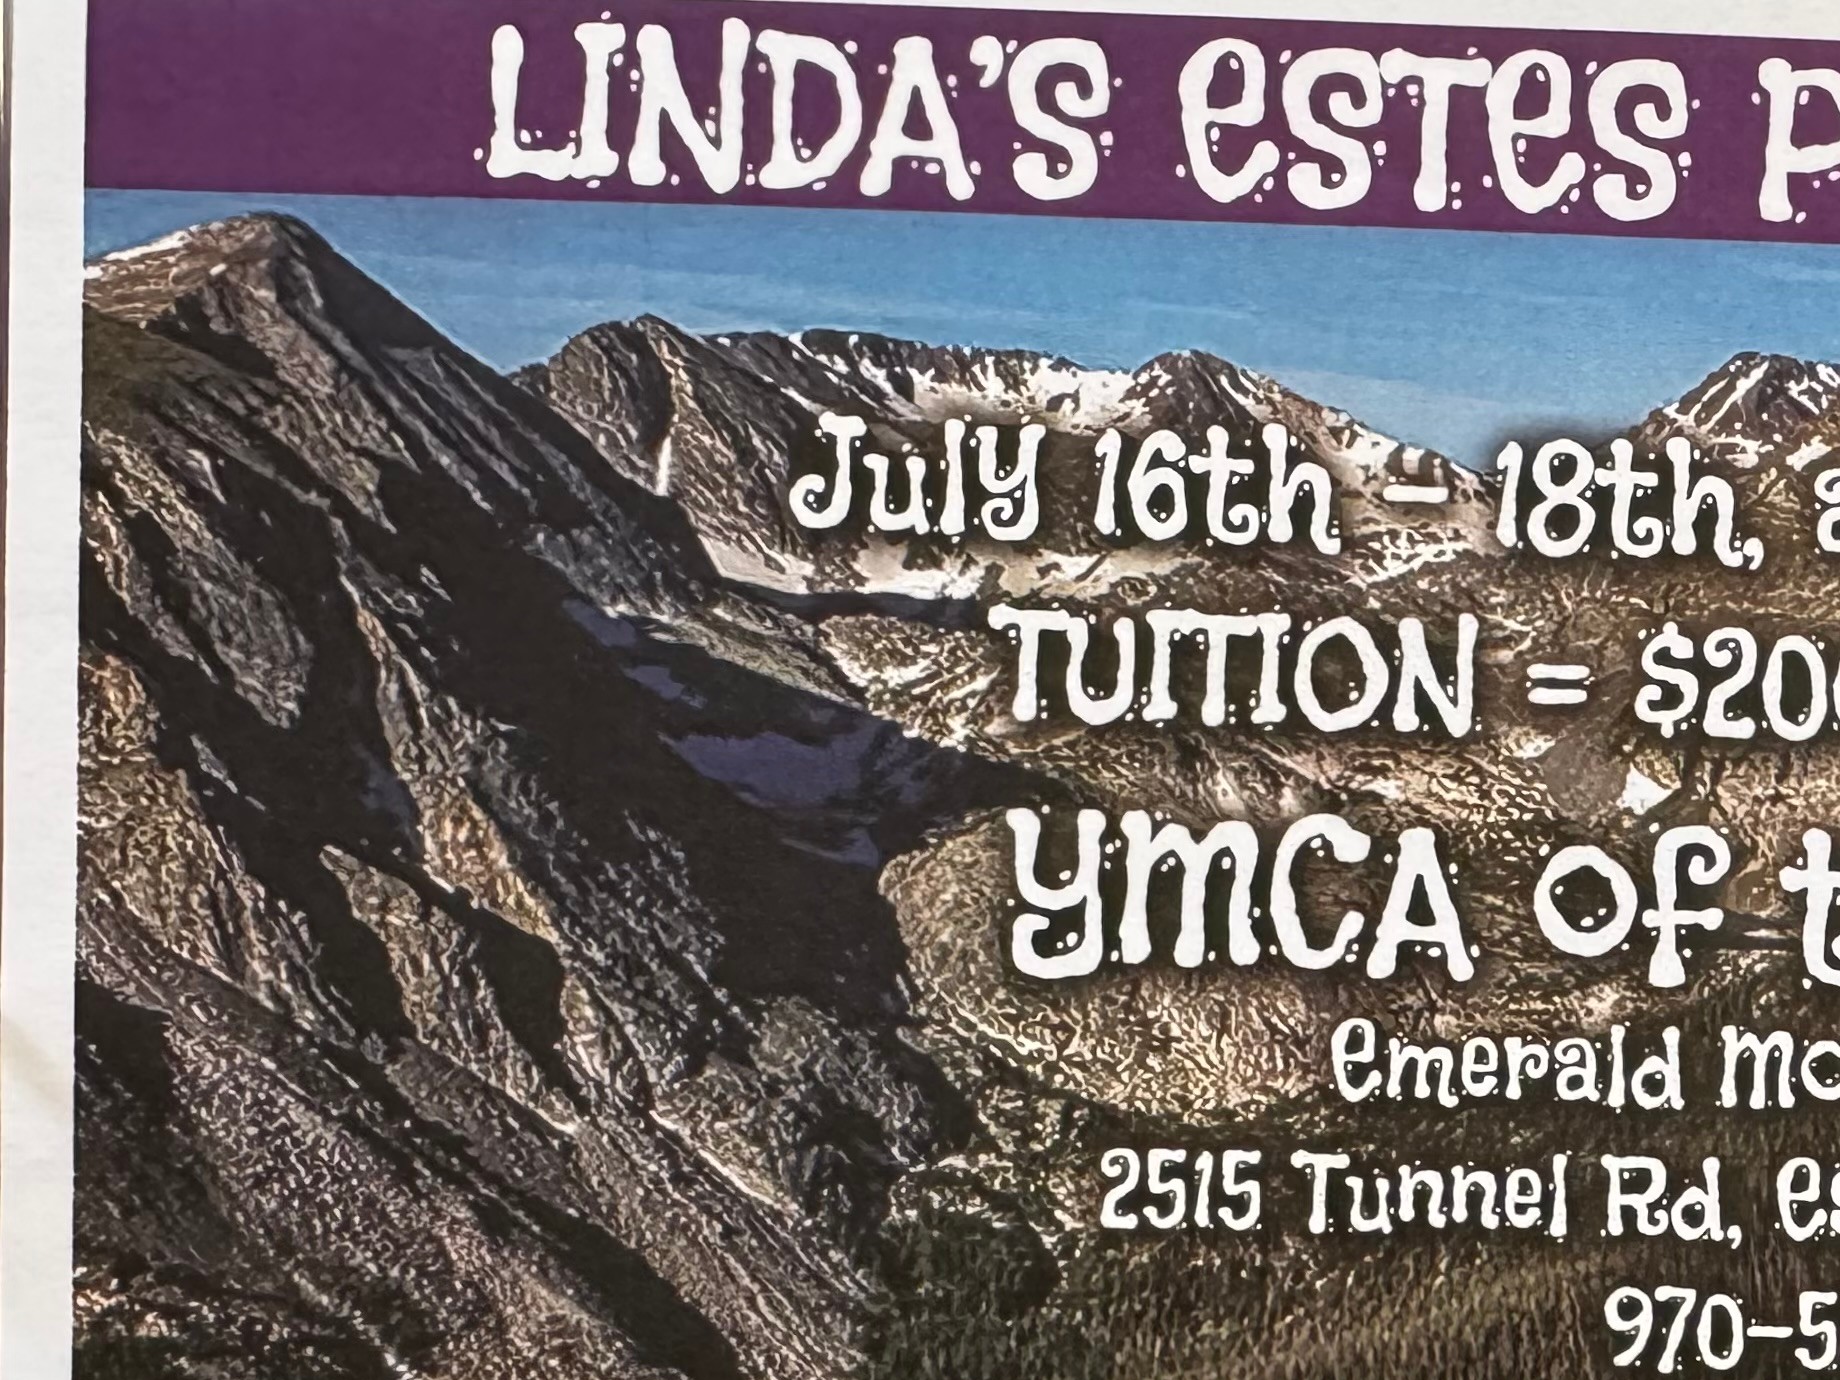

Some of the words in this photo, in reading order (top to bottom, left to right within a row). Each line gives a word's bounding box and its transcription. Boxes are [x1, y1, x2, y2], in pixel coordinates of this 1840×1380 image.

[487, 18, 1110, 200] LINDA'S
[788, 412, 1044, 540] July
[1095, 422, 1341, 555] 16th
[1496, 437, 1763, 567] 18th,
[984, 603, 1479, 737] TUITION
[1534, 826, 1731, 987] of
[1100, 1148, 1261, 1230] 2515
[1291, 1150, 1567, 1237] Tunnel
[1601, 1154, 1742, 1249] Rd,
